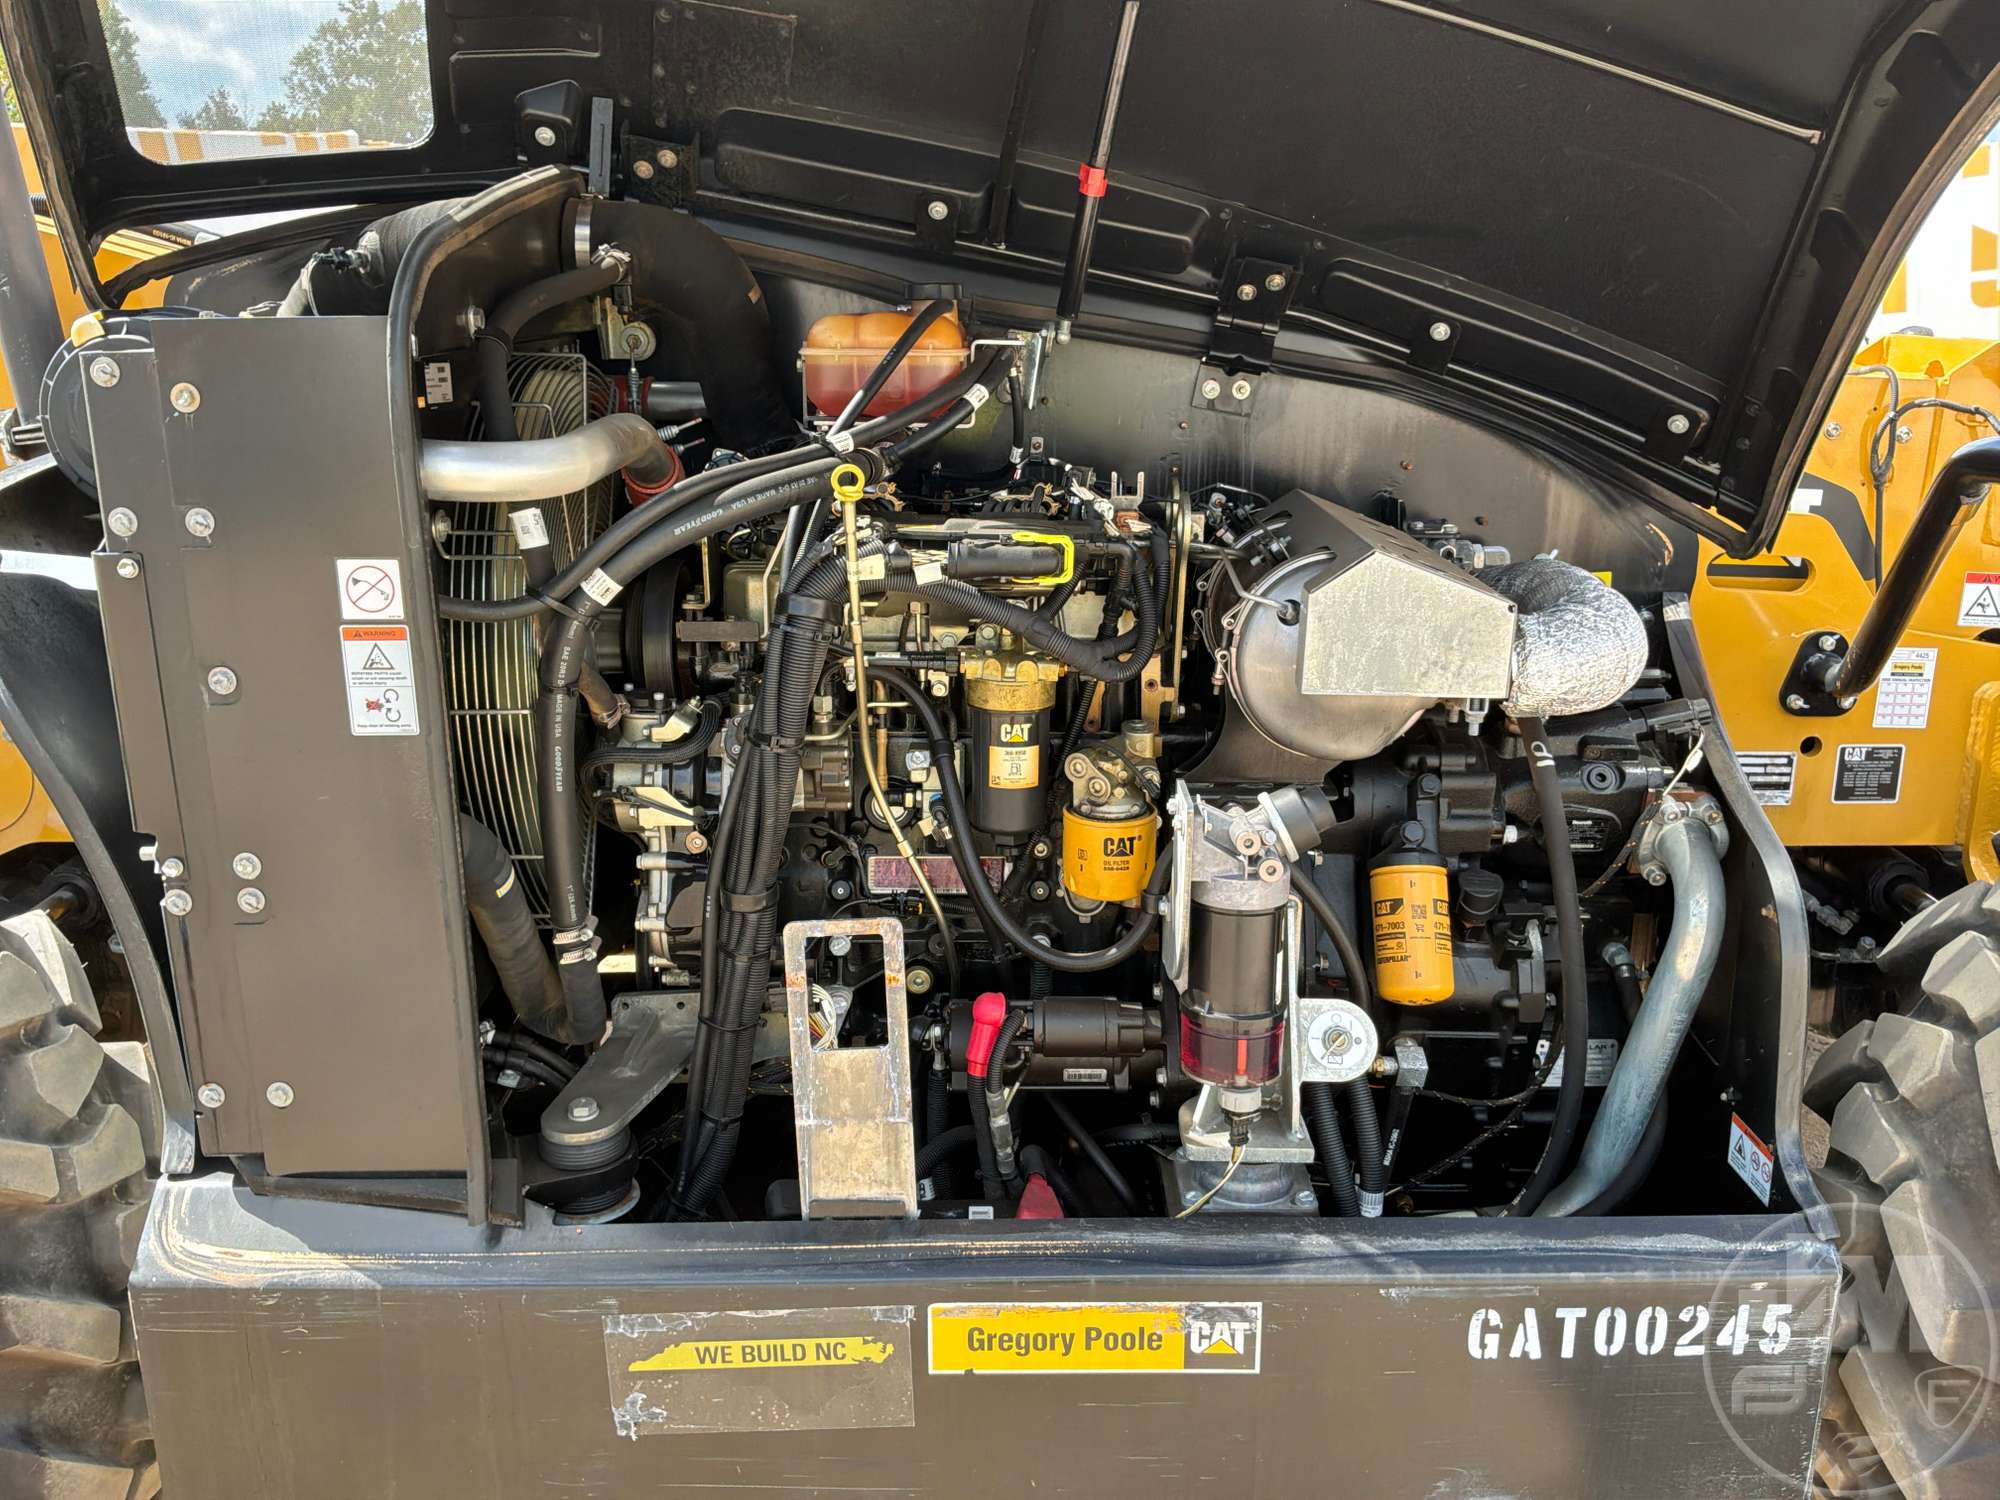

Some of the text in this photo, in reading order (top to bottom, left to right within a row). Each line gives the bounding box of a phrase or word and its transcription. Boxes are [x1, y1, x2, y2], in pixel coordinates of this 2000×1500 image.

[731, 501, 747, 510] USA
[756, 490, 776, 501] MADE
[673, 508, 723, 536] GOODYEAR
[555, 694, 563, 715] MADE
[555, 722, 563, 738] USA
[1000, 723, 1032, 743] CAT
[1844, 747, 1867, 761] CAT
[555, 745, 563, 792] GOODYEAR
[1103, 836, 1137, 858] CAT
[967, 1320, 1251, 1357] Gregory Poole CAT
[1467, 1304, 1793, 1360] GAT00245
[694, 1341, 847, 1365] WE BUILD NC
